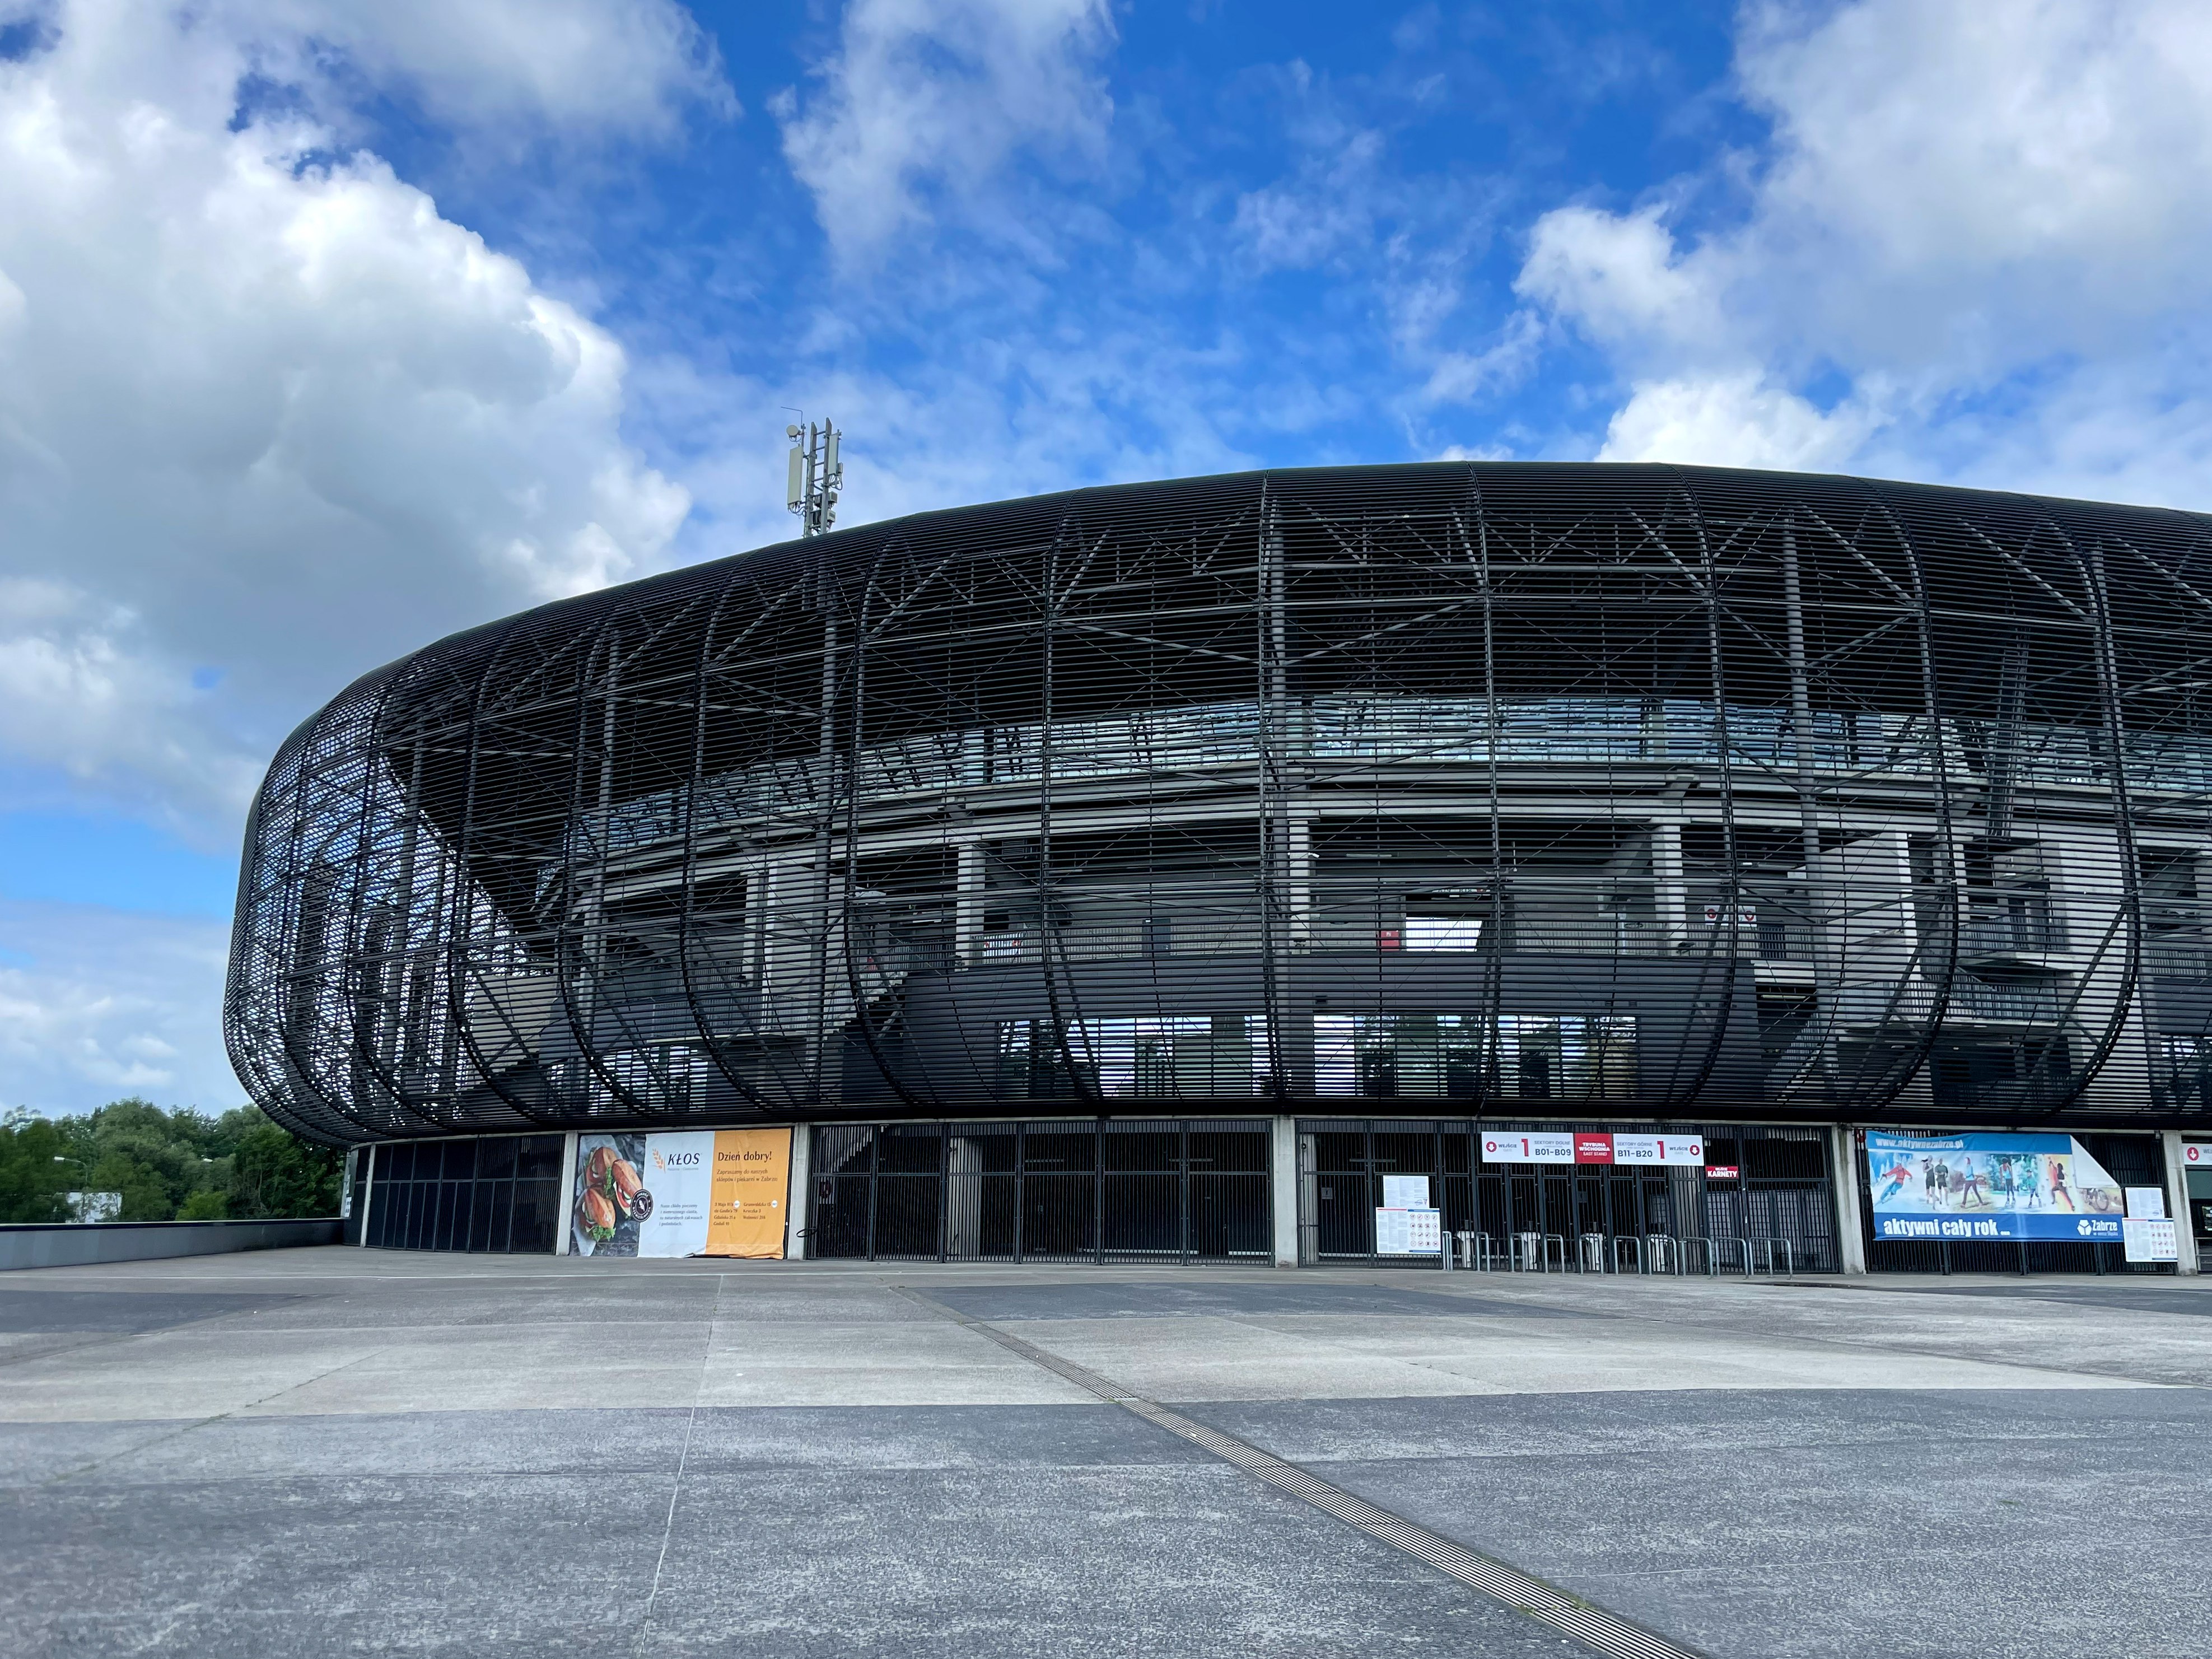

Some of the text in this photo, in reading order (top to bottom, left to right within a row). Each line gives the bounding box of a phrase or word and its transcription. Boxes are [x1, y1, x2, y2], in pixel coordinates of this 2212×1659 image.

[1521, 1138, 1529, 1157] 1
[1657, 1140, 1665, 1159] 1
[1876, 1139, 1963, 1149] www.aktywnezabrze.pl
[668, 1153, 700, 1165] KŁOS
[718, 1150, 772, 1163] Dzień dobry!
[1883, 1218, 1940, 1237] aktywni
[1942, 1219, 1971, 1237] cały
[1974, 1219, 1999, 1236] rok
[2092, 1219, 2118, 1231] Zabrze
